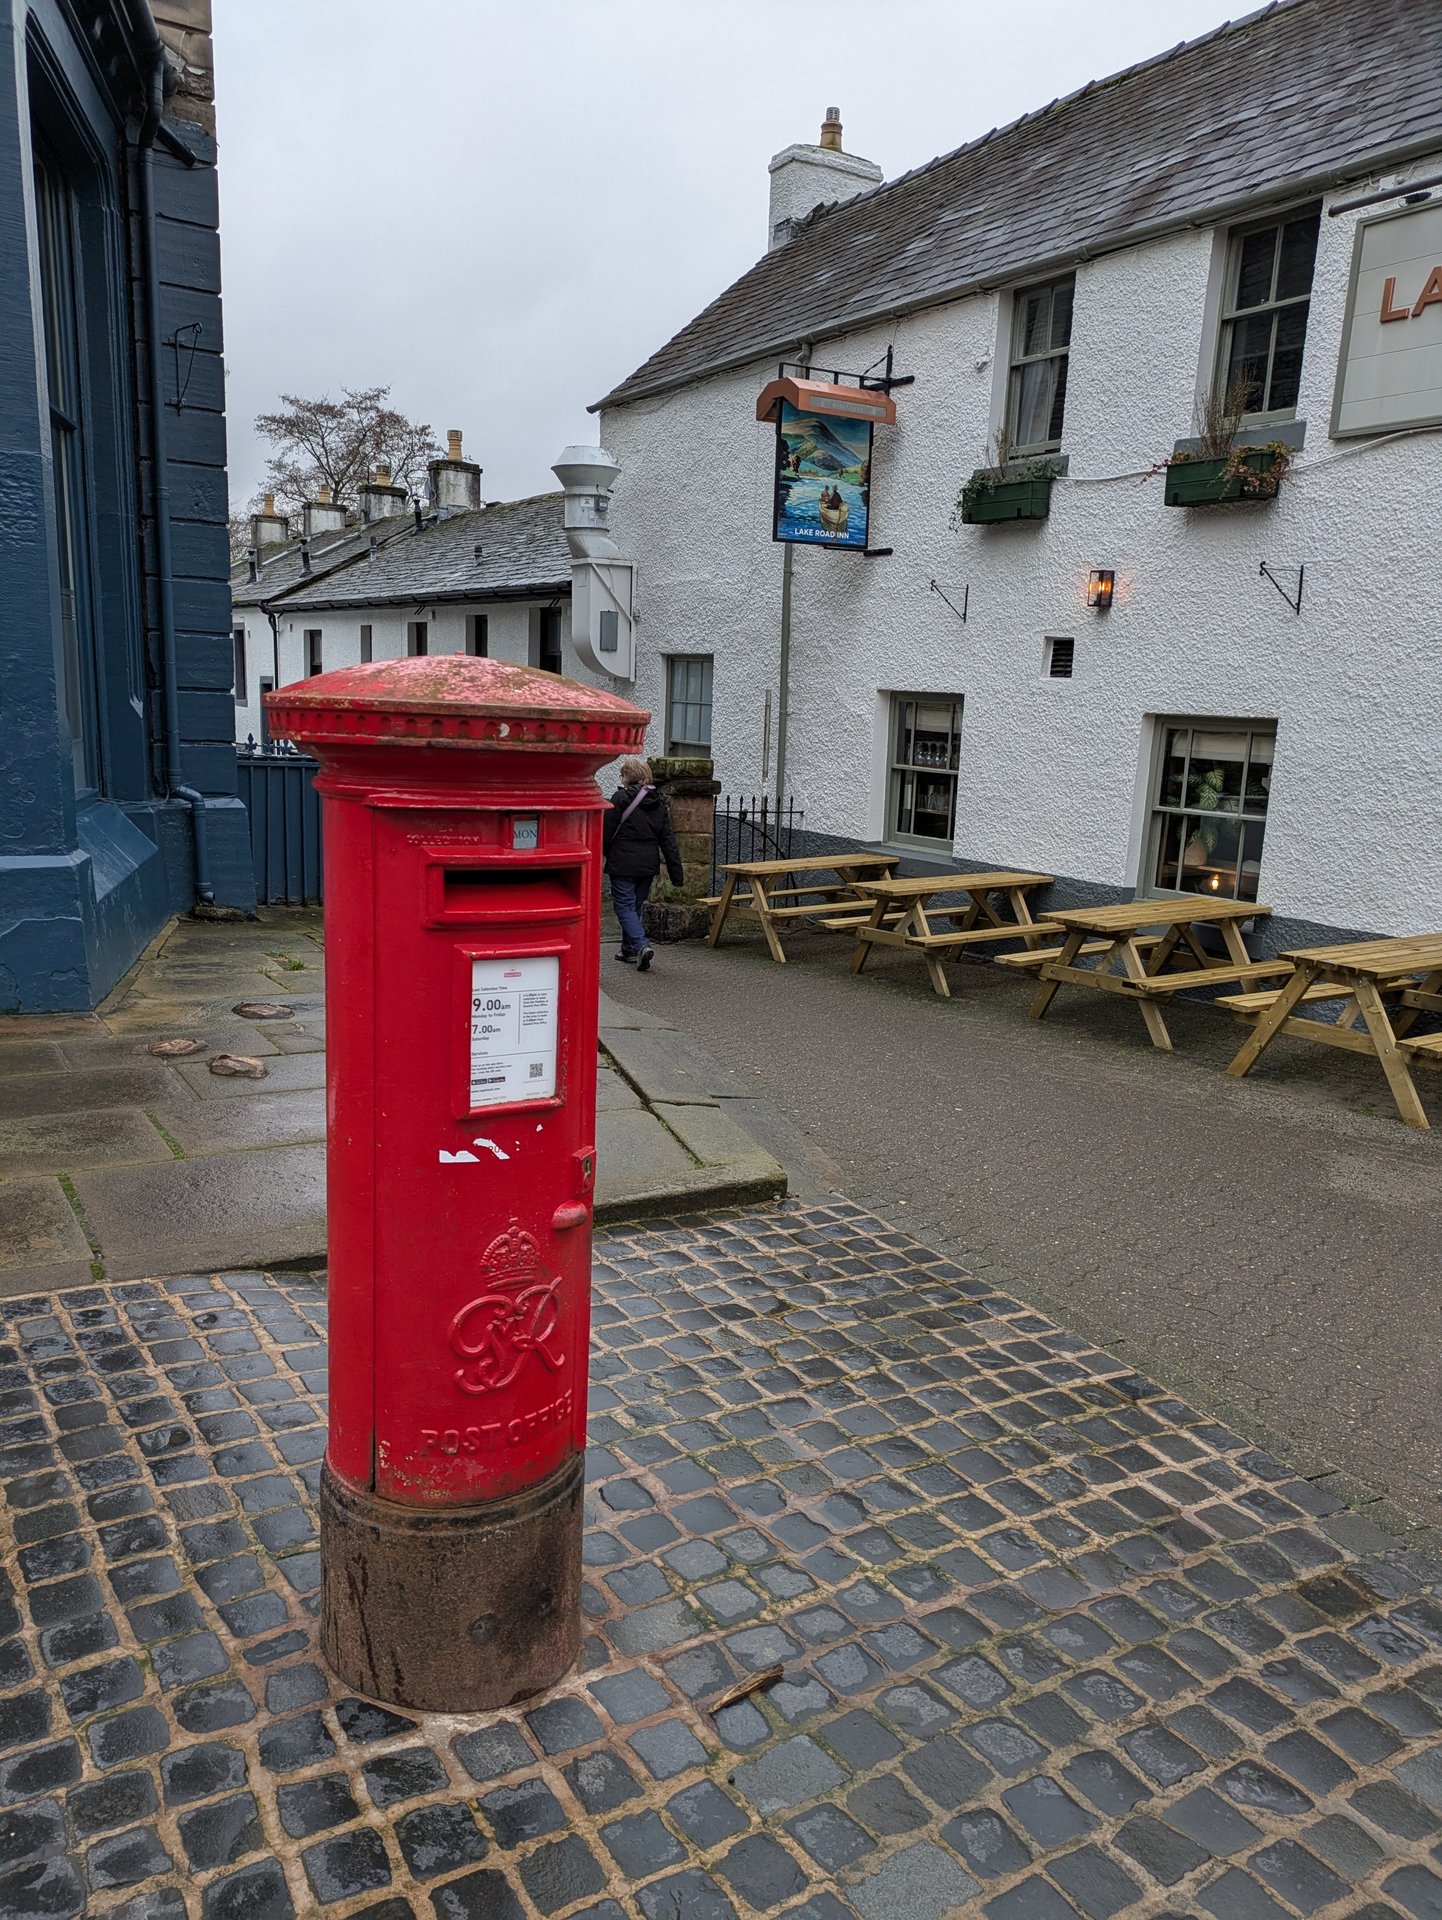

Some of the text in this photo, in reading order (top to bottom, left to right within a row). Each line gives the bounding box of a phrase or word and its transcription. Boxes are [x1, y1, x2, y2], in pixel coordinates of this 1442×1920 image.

[794, 527, 850, 540] LAKE ROAD INN
[513, 829, 538, 839] MON
[420, 1421, 501, 1456] POST
